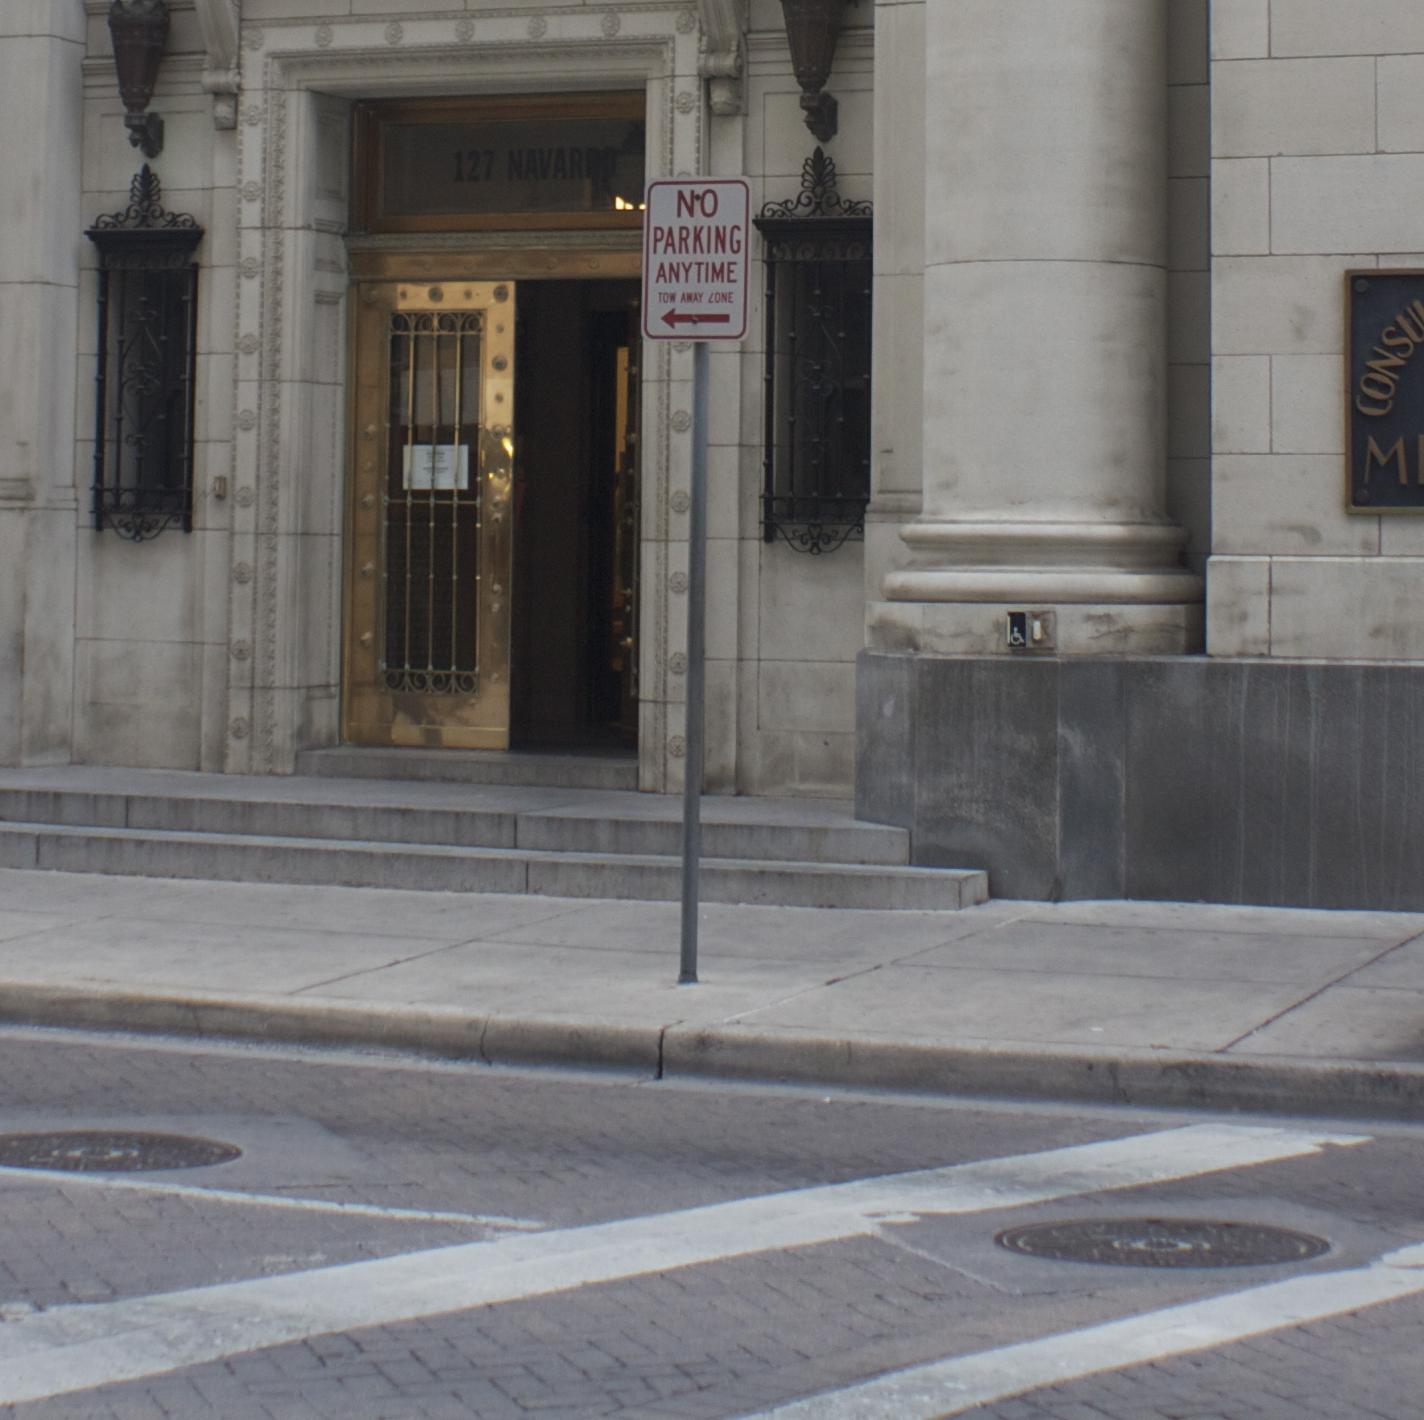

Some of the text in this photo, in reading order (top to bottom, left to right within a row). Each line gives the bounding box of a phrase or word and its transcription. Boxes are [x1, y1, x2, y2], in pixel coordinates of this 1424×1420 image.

[454, 150, 496, 182] 127
[676, 188, 718, 218] NO
[653, 225, 741, 255] PARKING
[655, 262, 737, 283] ANYTIME
[658, 292, 734, 303] TOW AWAY ZONE
